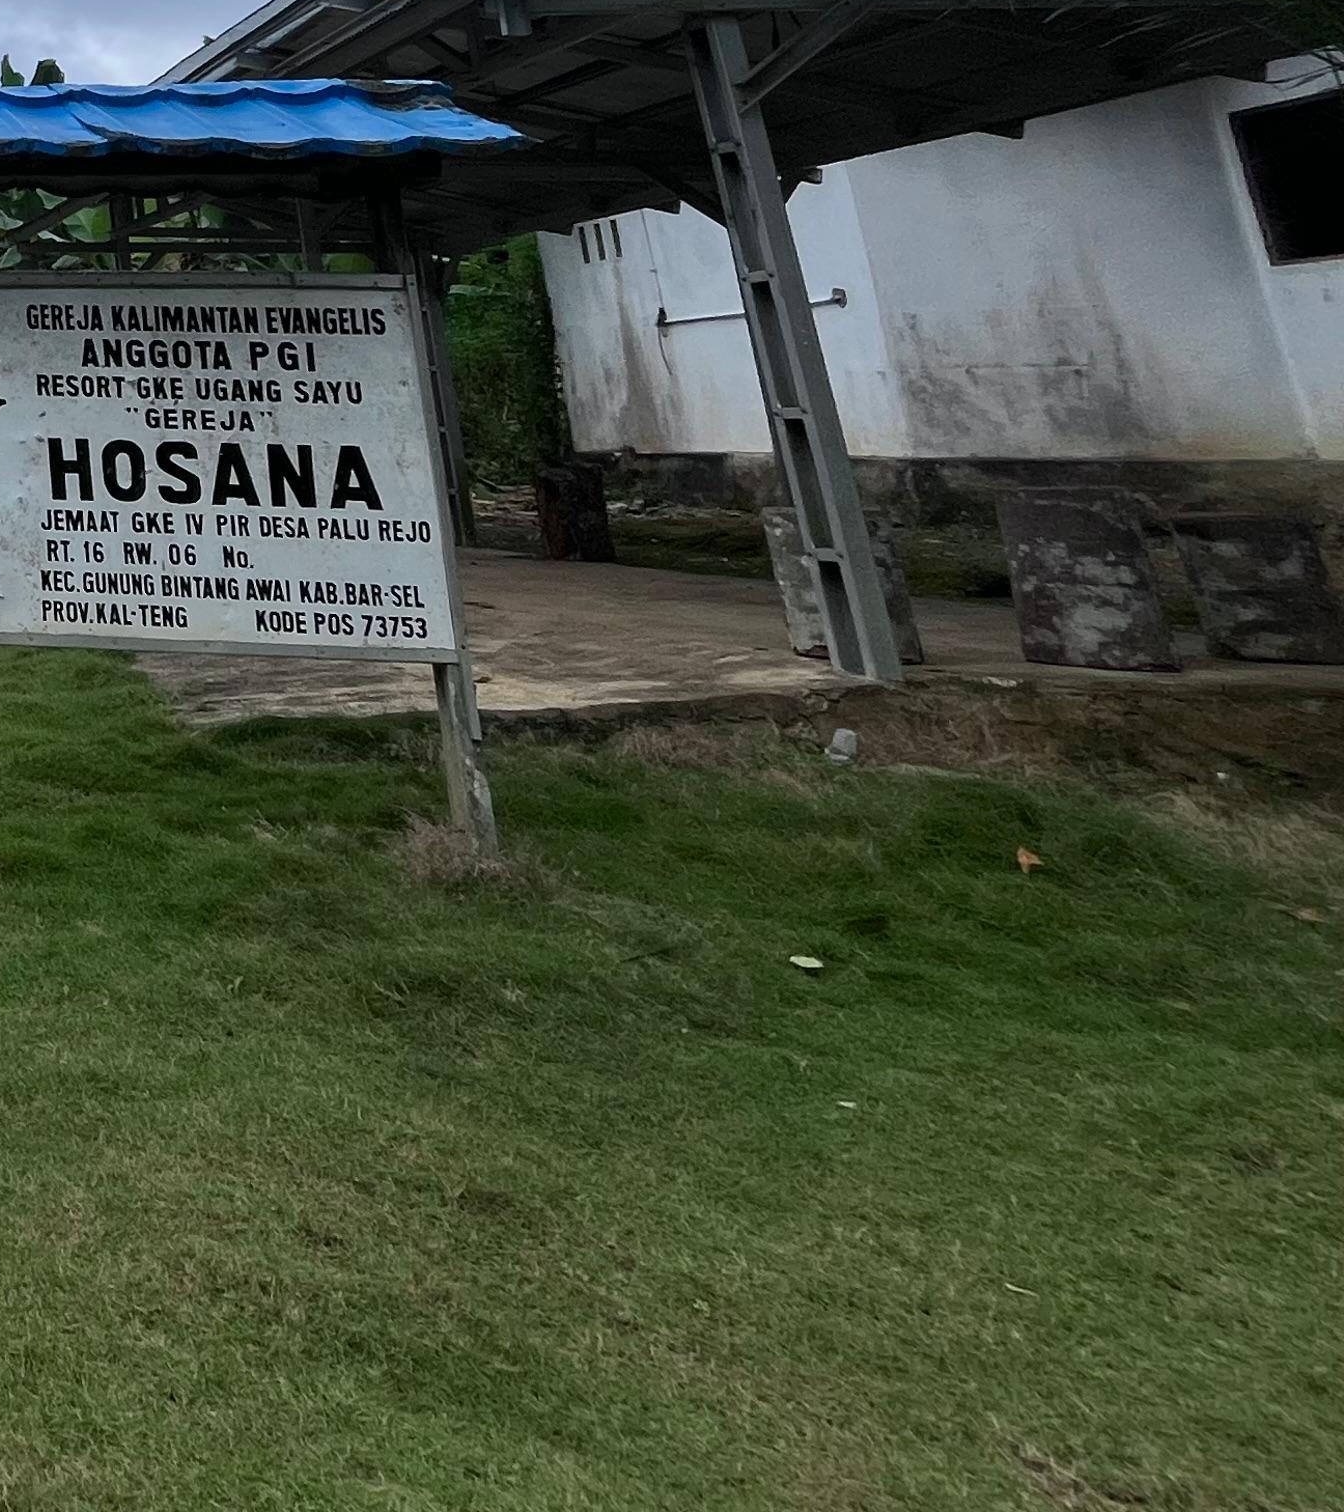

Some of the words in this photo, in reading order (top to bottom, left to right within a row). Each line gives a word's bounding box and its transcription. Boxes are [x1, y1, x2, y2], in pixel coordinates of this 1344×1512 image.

[26, 304, 103, 331] GEREJA
[112, 305, 259, 334] KALIMANTAN
[266, 307, 386, 335] EVANGELIS
[81, 339, 231, 371] ANGGOTA
[250, 341, 316, 372] PGI
[37, 375, 125, 399] RESORT
[137, 377, 183, 400] GKE
[197, 378, 281, 402] UGANG
[295, 381, 363, 404] SAYU
[126, 407, 272, 432] "GEREJA"
[48, 437, 384, 510] HOSANA
[41, 510, 119, 533] JEMAAT
[132, 512, 174, 534] GKE
[186, 514, 203, 534] IV
[217, 515, 249, 536] PIR
[260, 516, 310, 539] DESA
[318, 519, 369, 541] PALU
[379, 520, 431, 543] REJO
[47, 541, 75, 563] RT.
[83, 542, 104, 563] 16
[123, 543, 157, 565] RW.
[169, 544, 196, 566] 06
[224, 546, 254, 568] No.
[161, 576, 239, 600] BINTANG
[246, 579, 290, 602] AWAI
[256, 610, 307, 633] KODE
[314, 613, 354, 636] POS
[361, 615, 427, 639] 73753
